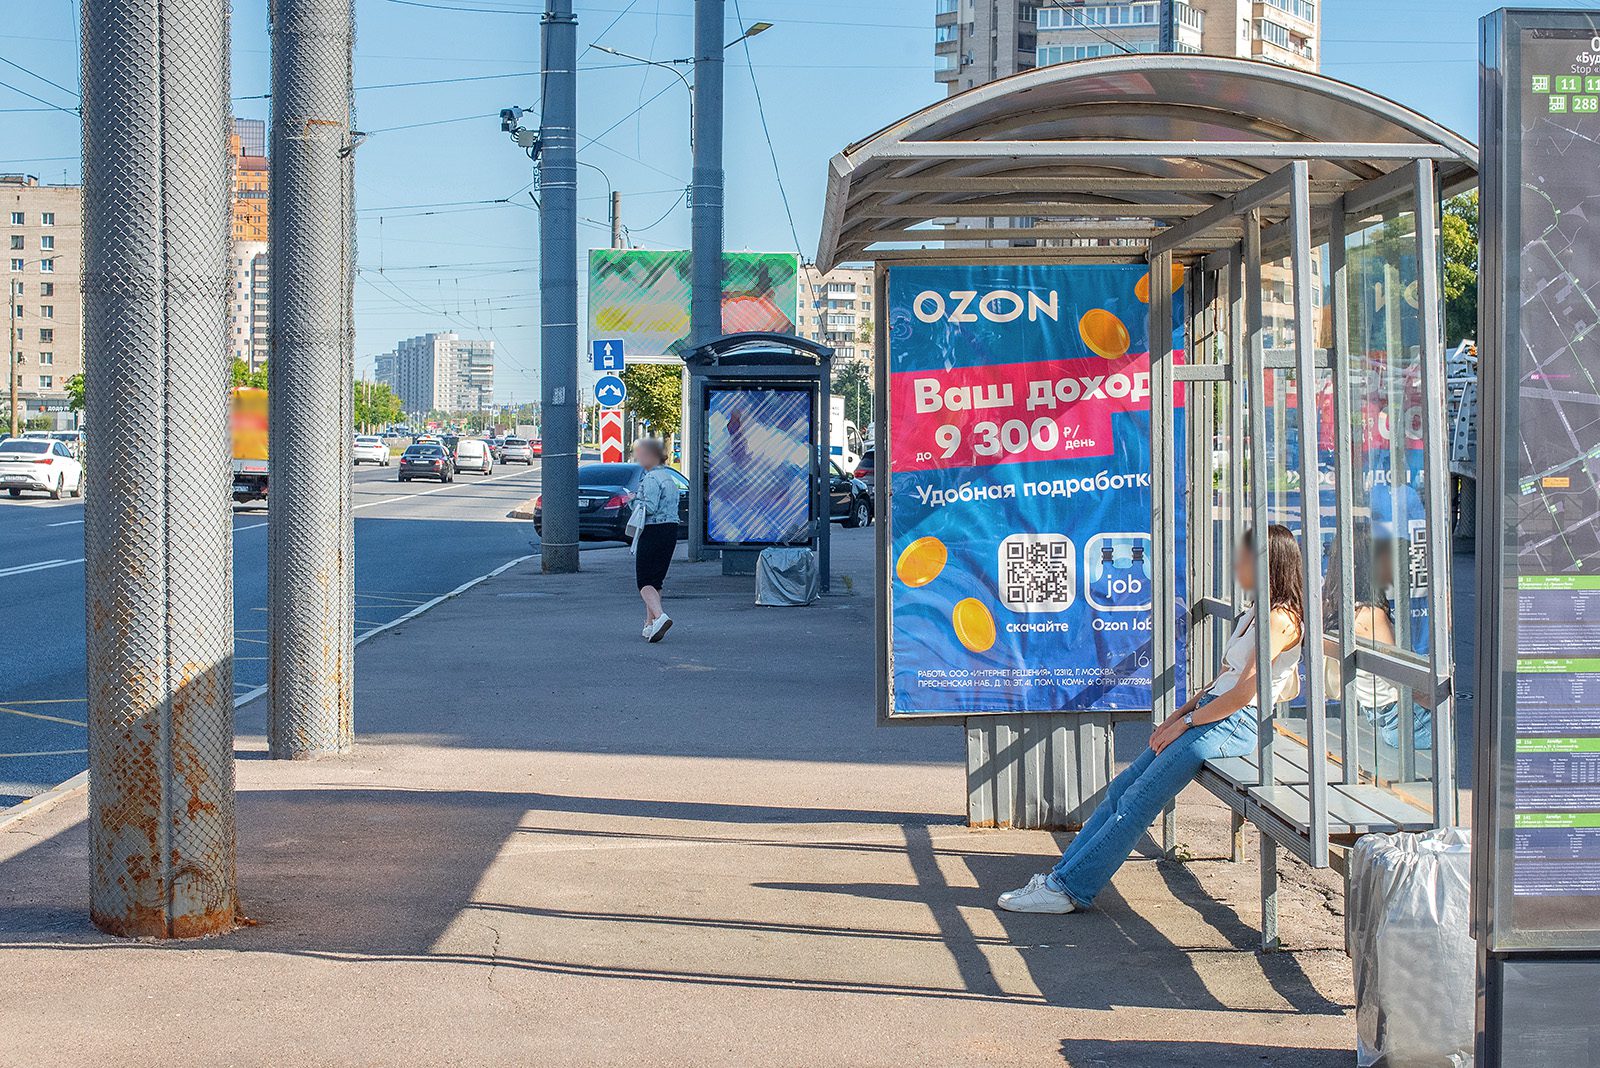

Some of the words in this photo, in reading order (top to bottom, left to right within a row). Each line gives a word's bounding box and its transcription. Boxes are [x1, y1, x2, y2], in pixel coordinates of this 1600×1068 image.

[1571, 64, 1591, 75] Stop
[1561, 79, 1576, 90] 11
[1574, 98, 1597, 110] 288
[912, 289, 1059, 323] OZON
[913, 378, 1014, 414] Ваш
[1026, 372, 1151, 411] доход
[915, 451, 932, 463] до
[934, 424, 962, 459] 9
[973, 416, 1060, 457] 300
[1065, 438, 1095, 451] день
[915, 482, 1015, 507] Удобная
[1023, 470, 1152, 497] подработк
[1106, 573, 1142, 598] job
[1005, 620, 1069, 633] скачайте
[1092, 618, 1128, 631] Ozon
[1132, 650, 1152, 668] 16
[948, 669, 969, 677] ООО
[970, 669, 1011, 677] «ИНТЕРНЕТ
[917, 679, 972, 688] ПРЕСНЕНСКАЯ
